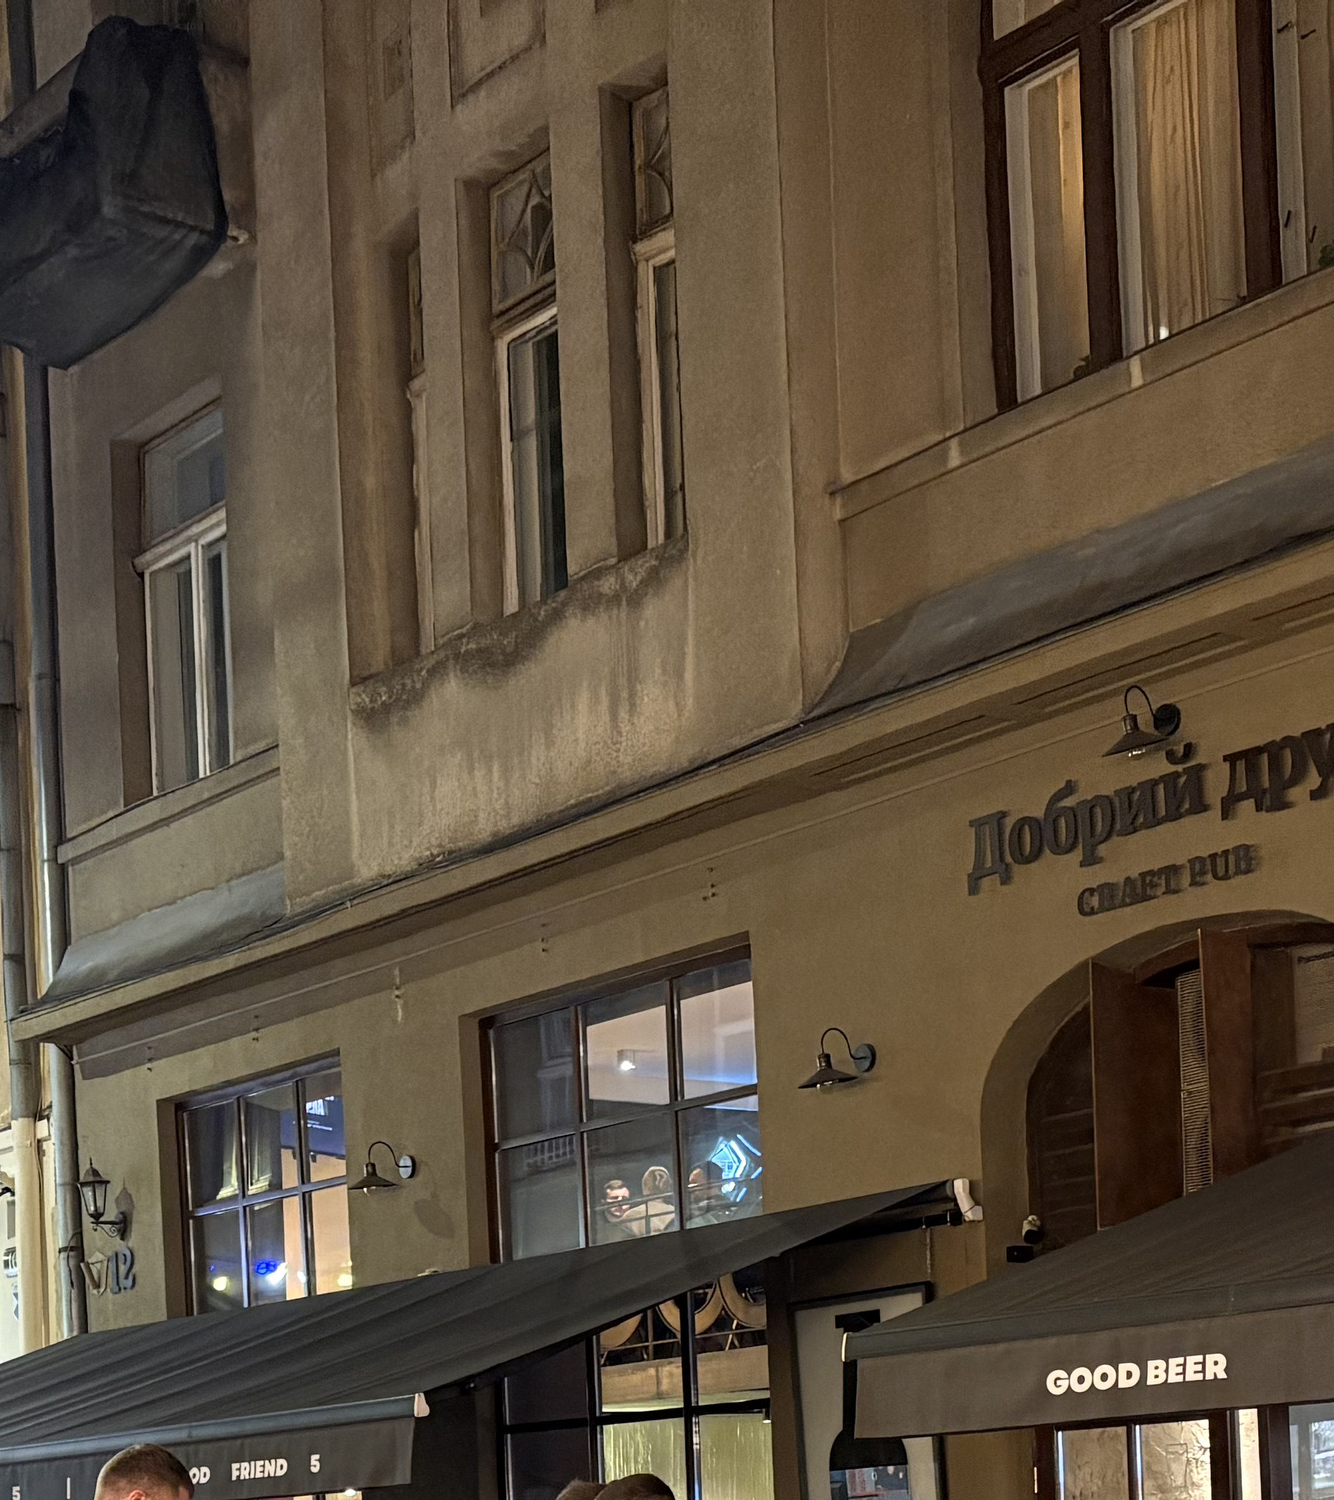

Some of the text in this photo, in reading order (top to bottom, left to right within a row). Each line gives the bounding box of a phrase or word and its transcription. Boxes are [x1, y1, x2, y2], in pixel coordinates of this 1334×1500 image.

[967, 741, 1210, 896] Добрий
[1077, 843, 1257, 917] CRAFT PUB
[1045, 1352, 1228, 1396] GOOD BEER
[188, 1454, 321, 1486] OD FRIEND 5
